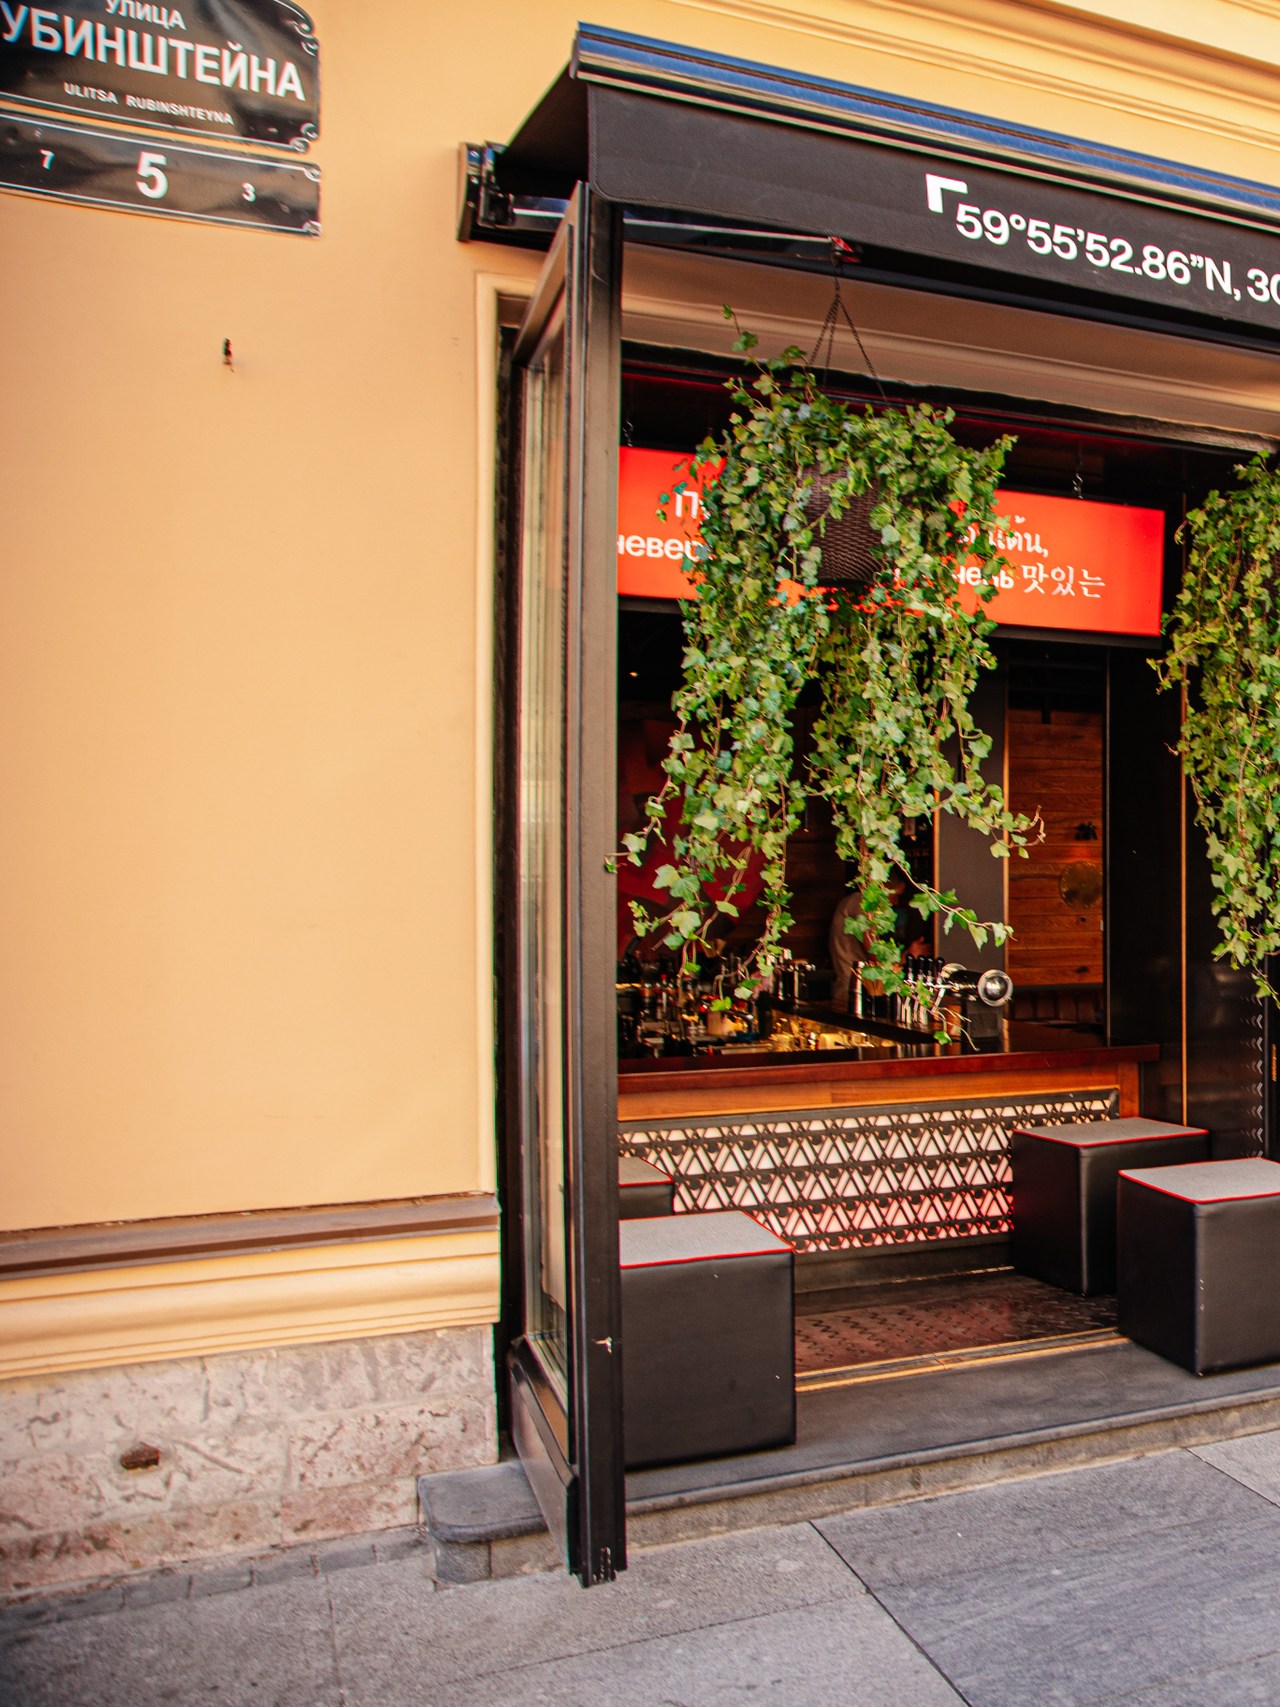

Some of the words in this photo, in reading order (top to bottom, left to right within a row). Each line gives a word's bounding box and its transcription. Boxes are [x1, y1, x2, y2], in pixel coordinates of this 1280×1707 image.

[105, 0, 187, 30] УЛИЦА
[63, 82, 118, 105] ULITSA
[126, 93, 234, 125] RUBINSHTEYNA
[40, 149, 54, 169] 7
[136, 151, 168, 199] 5
[241, 182, 256, 202] 3
[1021, 562, 1105, 598] 맛있는
